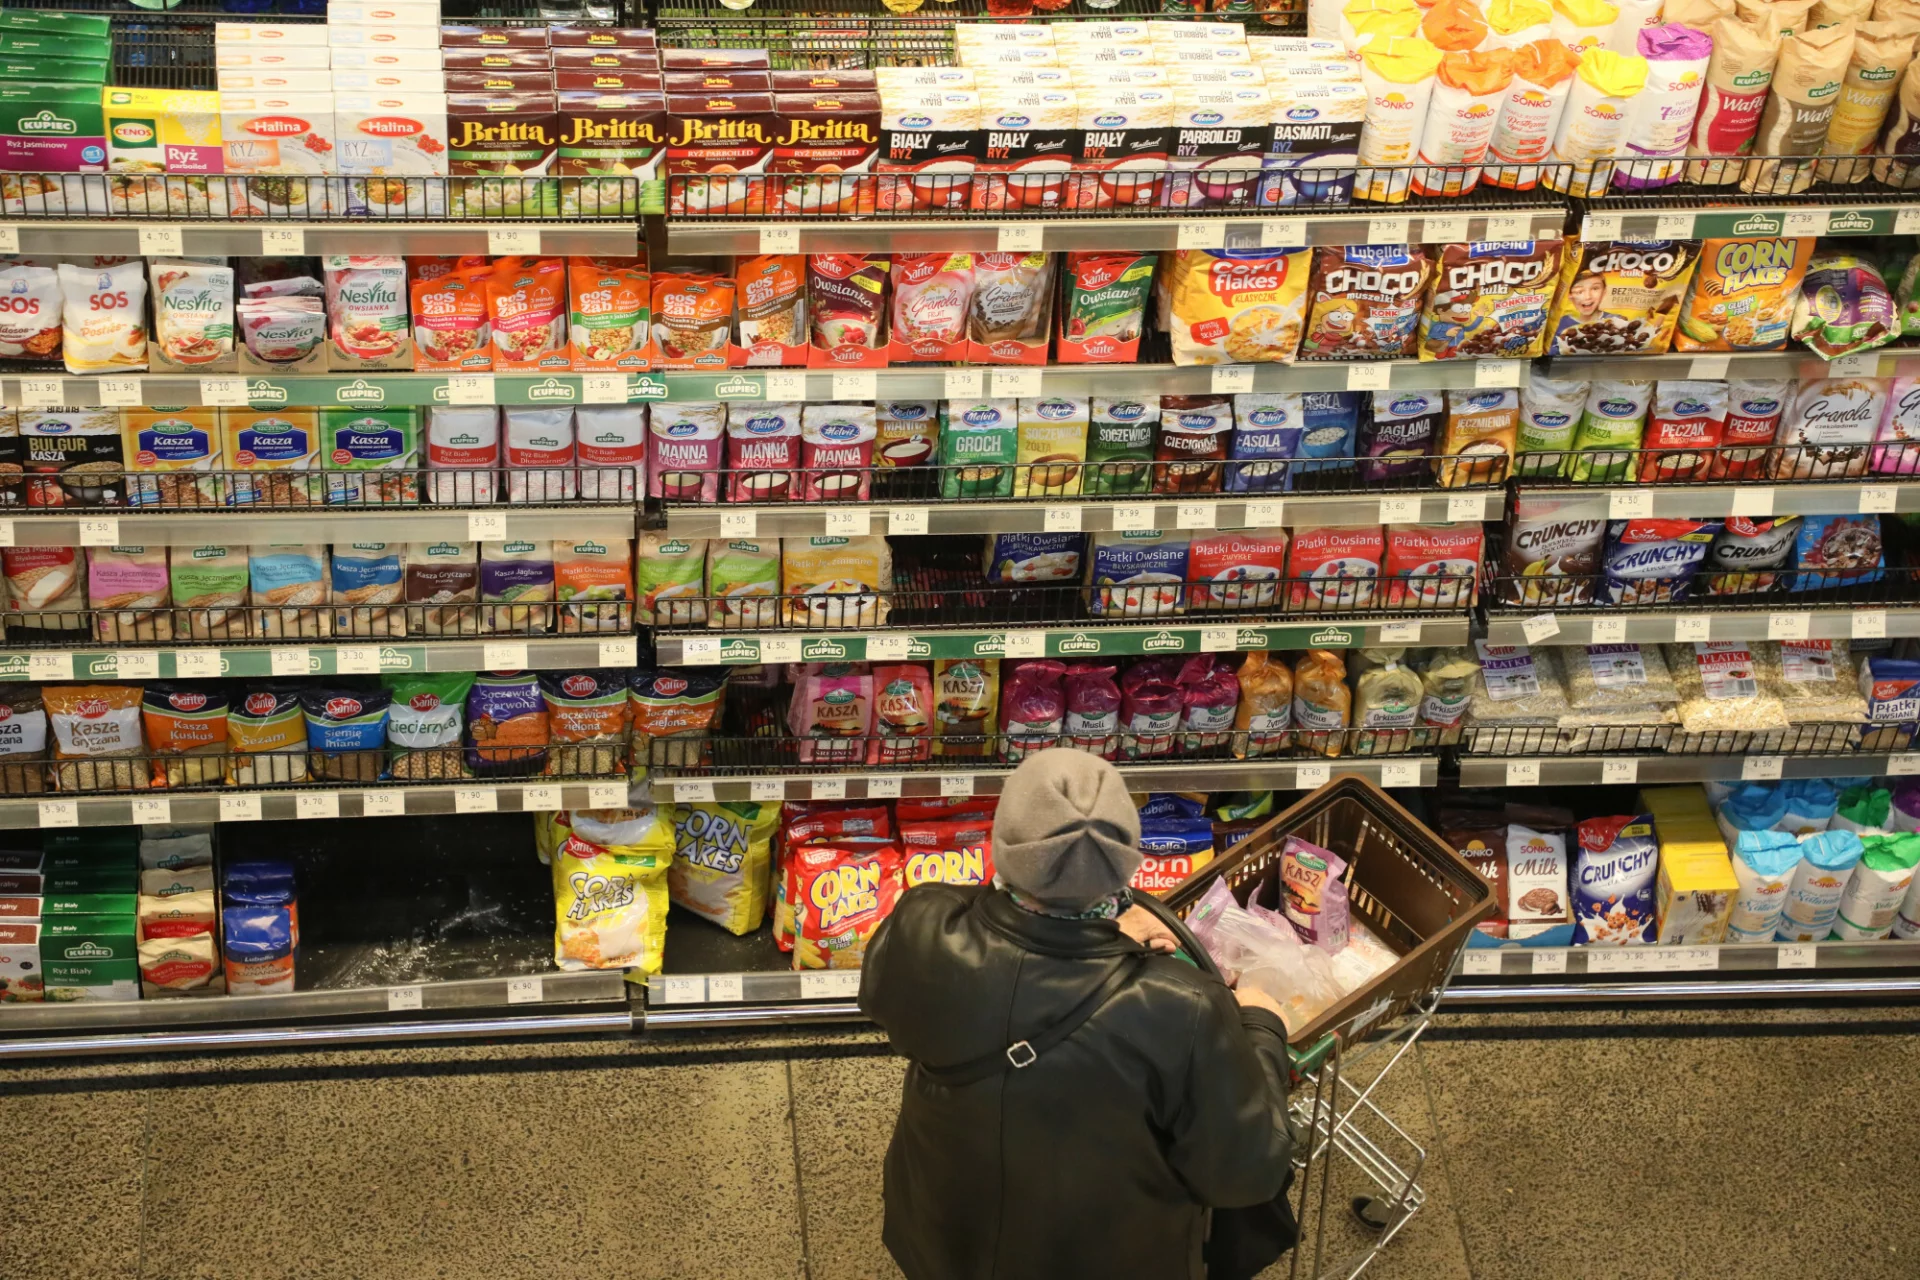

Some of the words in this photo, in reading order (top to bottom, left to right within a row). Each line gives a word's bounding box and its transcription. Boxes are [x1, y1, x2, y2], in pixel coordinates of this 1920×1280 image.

[1736, 73, 1769, 85] KUPIEC
[1862, 69, 1895, 79] KUPIEC
[1375, 97, 1414, 109] SONKO
[1511, 94, 1552, 107] SONKO
[1584, 106, 1623, 120] SONKO
[23, 120, 73, 131] KUPIEC
[254, 121, 302, 132] Halina
[368, 121, 414, 133] Halina
[115, 127, 152, 137] CENOS
[450, 121, 555, 147] Britta
[560, 118, 663, 147] Britta
[670, 119, 773, 146] Britta
[776, 120, 877, 145] Britta
[1179, 129, 1242, 144] PARBOILED
[1274, 125, 1331, 141] BASMATI
[891, 133, 932, 150] BIAŁY
[988, 133, 1029, 148] BIAŁY
[890, 146, 912, 159] RYŻ
[987, 146, 1009, 158] RYŻ
[1177, 145, 1198, 156] RYŻ
[1272, 141, 1292, 153] RYŻ
[168, 148, 198, 163] Ryż
[706, 149, 753, 158] PARBOILED
[170, 162, 207, 170] parboiled
[1664, 218, 1685, 226] 3.00
[1790, 214, 1812, 223] 2.99
[1268, 224, 1290, 233] 5.90
[1738, 222, 1776, 232] KUPIEC
[146, 232, 170, 241] 4.70
[270, 232, 292, 240] 4.50
[495, 232, 517, 240] 4.90
[767, 230, 788, 238] 4.69
[1004, 229, 1026, 237] 3.80
[1351, 246, 1402, 259] Lubella
[1716, 239, 1796, 270] CORN
[813, 258, 841, 275] Sante
[1212, 258, 1283, 275] Corn
[1589, 251, 1673, 273] CHOCO
[1082, 271, 1111, 286] Sante
[1449, 261, 1542, 289] CHOCO
[1620, 268, 1644, 278] kulki
[1214, 273, 1277, 291] flakes
[1326, 271, 1418, 293] CHOCO
[1723, 267, 1789, 295] FLAKES
[340, 282, 396, 304] NesVita
[814, 276, 873, 309] Owsianka
[1480, 283, 1509, 296] kulki
[90, 291, 128, 310] SOS
[164, 291, 221, 312] NesVita
[1235, 292, 1277, 303] KLASYCZNE
[1347, 290, 1394, 303] muszelki
[0, 297, 39, 314] SOS
[831, 349, 862, 361] Sante
[465, 357, 490, 365] KUPIEC
[1837, 357, 1858, 365] 6.50
[28, 383, 56, 392] 11.90
[106, 383, 135, 391] 11.90
[207, 383, 229, 392] 2.10
[589, 380, 610, 389] 1.99
[342, 389, 379, 400] KUPIEC
[534, 388, 571, 399] KUPIEC
[1804, 399, 1872, 426] Granola
[1378, 419, 1430, 437] JAGLANA
[1660, 422, 1705, 438] PĘCZAK
[1099, 428, 1151, 442] SOCZEWICA
[29, 437, 87, 452] BULGUR
[153, 436, 193, 447] Kasza
[349, 436, 388, 446] Kasza
[956, 435, 1002, 453] GROCH
[31, 450, 65, 462] KASZA
[658, 442, 708, 459] MANNA
[814, 446, 861, 462] MANNA
[1867, 491, 1887, 499] 7.90
[1184, 507, 1203, 516] 4.90
[1252, 505, 1271, 513] 7.00
[726, 516, 746, 524] 4.50
[832, 514, 853, 522] 3.30
[896, 513, 915, 521] 4.20
[1051, 511, 1070, 520] 6.50
[87, 523, 108, 531] 6.50
[1516, 520, 1598, 548] CRUNCHY
[1297, 536, 1327, 549] Płatki
[1331, 535, 1380, 546] Owsiane
[430, 544, 459, 555] KUPIEC
[577, 545, 605, 553] KUPIEC
[1196, 543, 1227, 555] Płatki
[1229, 543, 1281, 553] Owsiane
[1322, 546, 1352, 554] ZWYKŁE
[1098, 550, 1131, 563] Płatki
[1133, 549, 1184, 562] Owsiane
[1613, 545, 1701, 572] CRUNCHY
[416, 570, 436, 580] Kasza
[438, 570, 471, 579] Gryczana
[1598, 621, 1617, 629] 6.50
[605, 645, 625, 653] 4.50
[689, 643, 708, 651] 4.50
[880, 639, 899, 648] 4.50
[1064, 642, 1097, 651] KUPIEC
[1147, 639, 1181, 649] KUPIEC
[723, 649, 755, 658] KUPIEC
[808, 646, 843, 657] KUPIEC
[36, 658, 57, 666] 3.50
[123, 656, 145, 664] 3.30
[183, 656, 204, 664] 3.30
[1486, 657, 1527, 669] PŁATKI
[1701, 653, 1746, 663] PŁATKI
[1704, 661, 1746, 670] OWSIANE
[565, 679, 595, 693] Sante
[172, 694, 204, 708] Sante
[483, 699, 536, 710] czerwona
[1876, 700, 1916, 712] Płatki
[328, 701, 361, 714] Sante
[816, 706, 859, 718] KASZA
[1875, 711, 1916, 719] OWSIANE
[70, 720, 119, 737] Kasza
[173, 721, 208, 732] Kasza
[72, 734, 121, 745] Gryczana
[171, 730, 213, 741] Kuskus
[241, 732, 285, 746] Sezam
[1609, 764, 1628, 772] 3.99
[1753, 760, 1772, 768] 4.50
[1513, 766, 1531, 774] 4.40
[369, 795, 389, 803] 5.50
[529, 790, 549, 798] 6.49
[138, 802, 159, 810] 6.90
[226, 800, 247, 808] 3.49
[1459, 849, 1493, 857] SONKO
[905, 848, 985, 884] CORN
[1514, 858, 1559, 876] Milk
[811, 862, 881, 910] CORN
[819, 890, 878, 928] FLAKES
[68, 948, 108, 957] KUPIEC
[513, 982, 533, 990] 6.90
